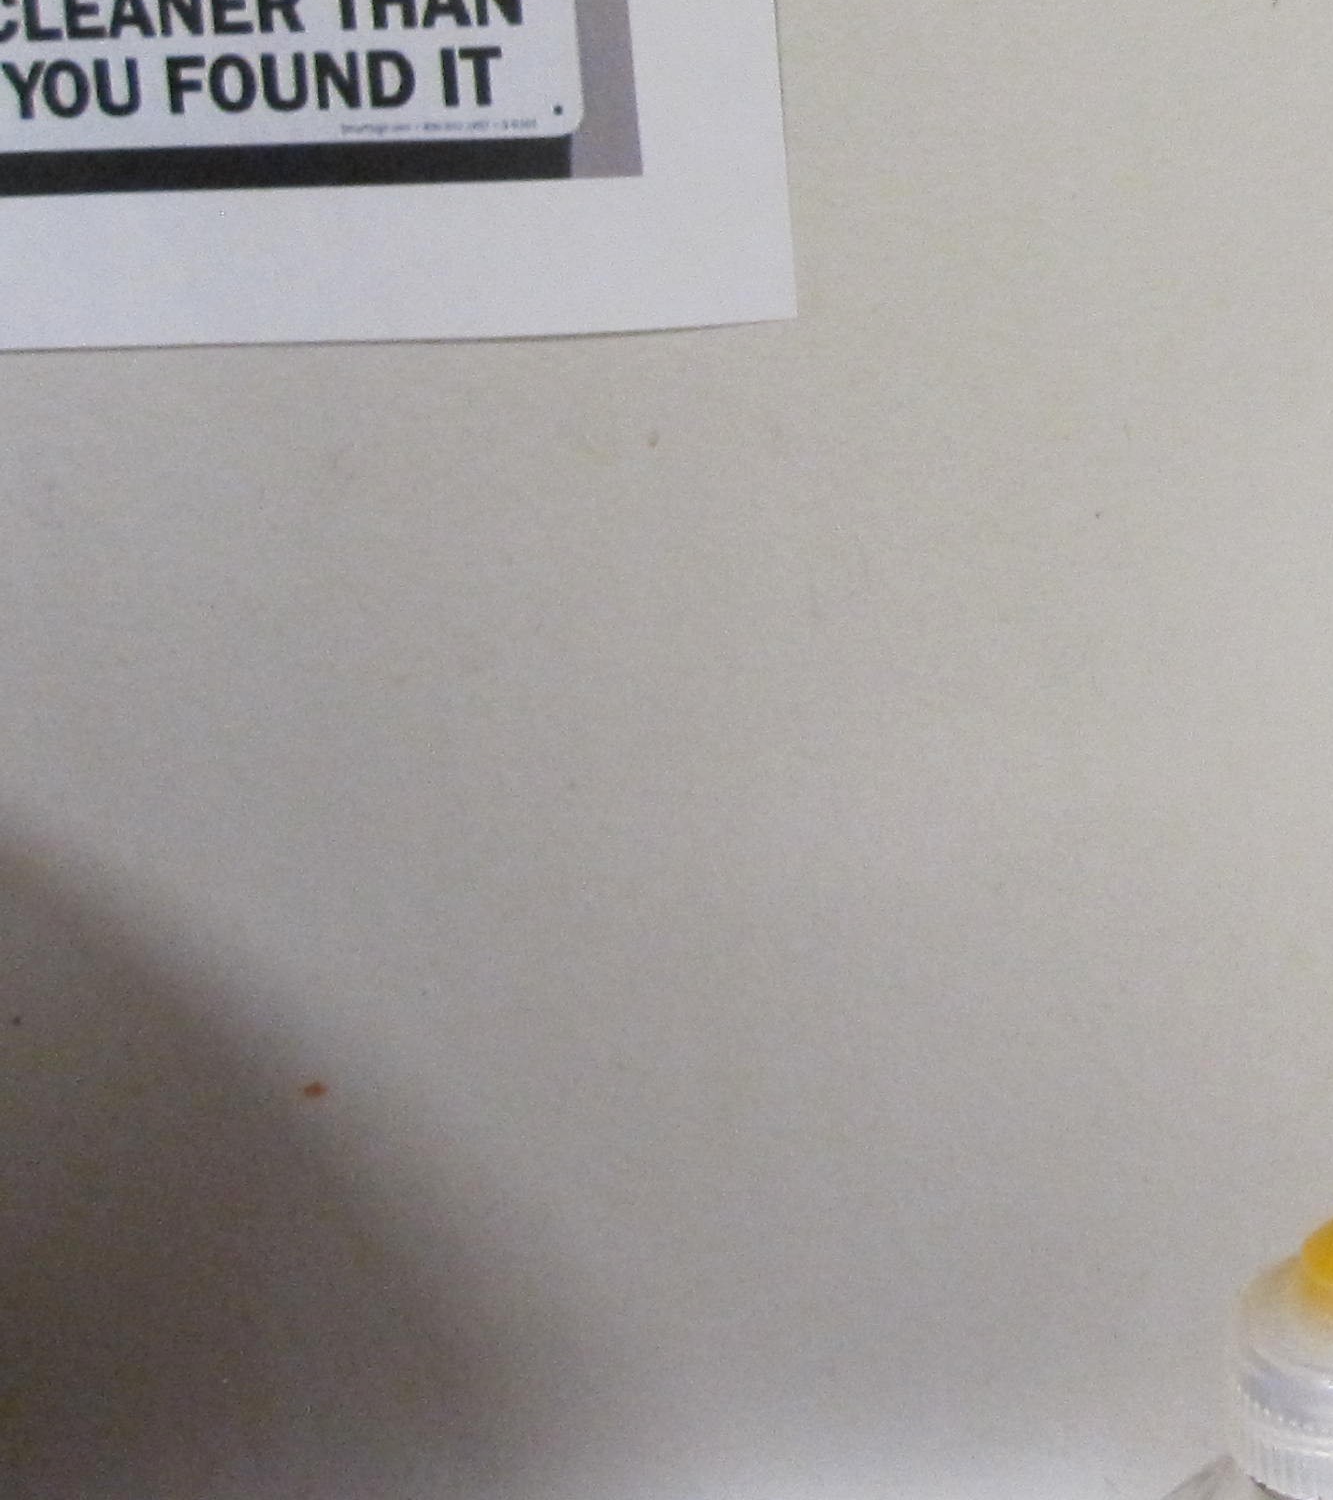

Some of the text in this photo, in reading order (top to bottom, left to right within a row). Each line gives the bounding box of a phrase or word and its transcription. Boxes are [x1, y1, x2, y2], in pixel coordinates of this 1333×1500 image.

[4, 46, 502, 120] YOU FOUND IT
